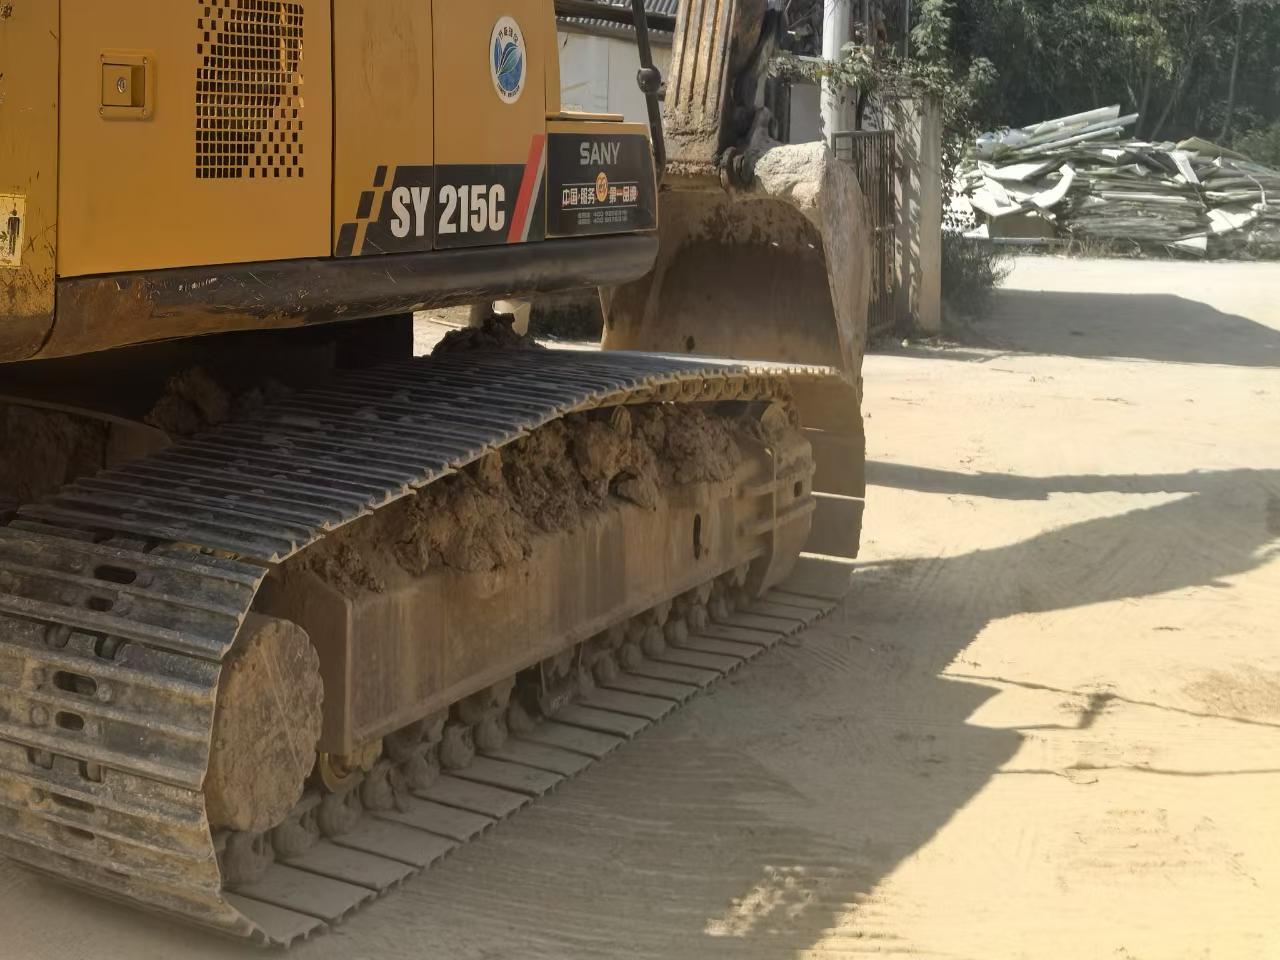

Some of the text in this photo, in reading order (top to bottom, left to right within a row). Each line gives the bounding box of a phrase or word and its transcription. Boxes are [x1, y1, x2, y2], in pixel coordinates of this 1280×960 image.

[579, 141, 621, 165] SANY
[390, 184, 505, 238] SY 215C
